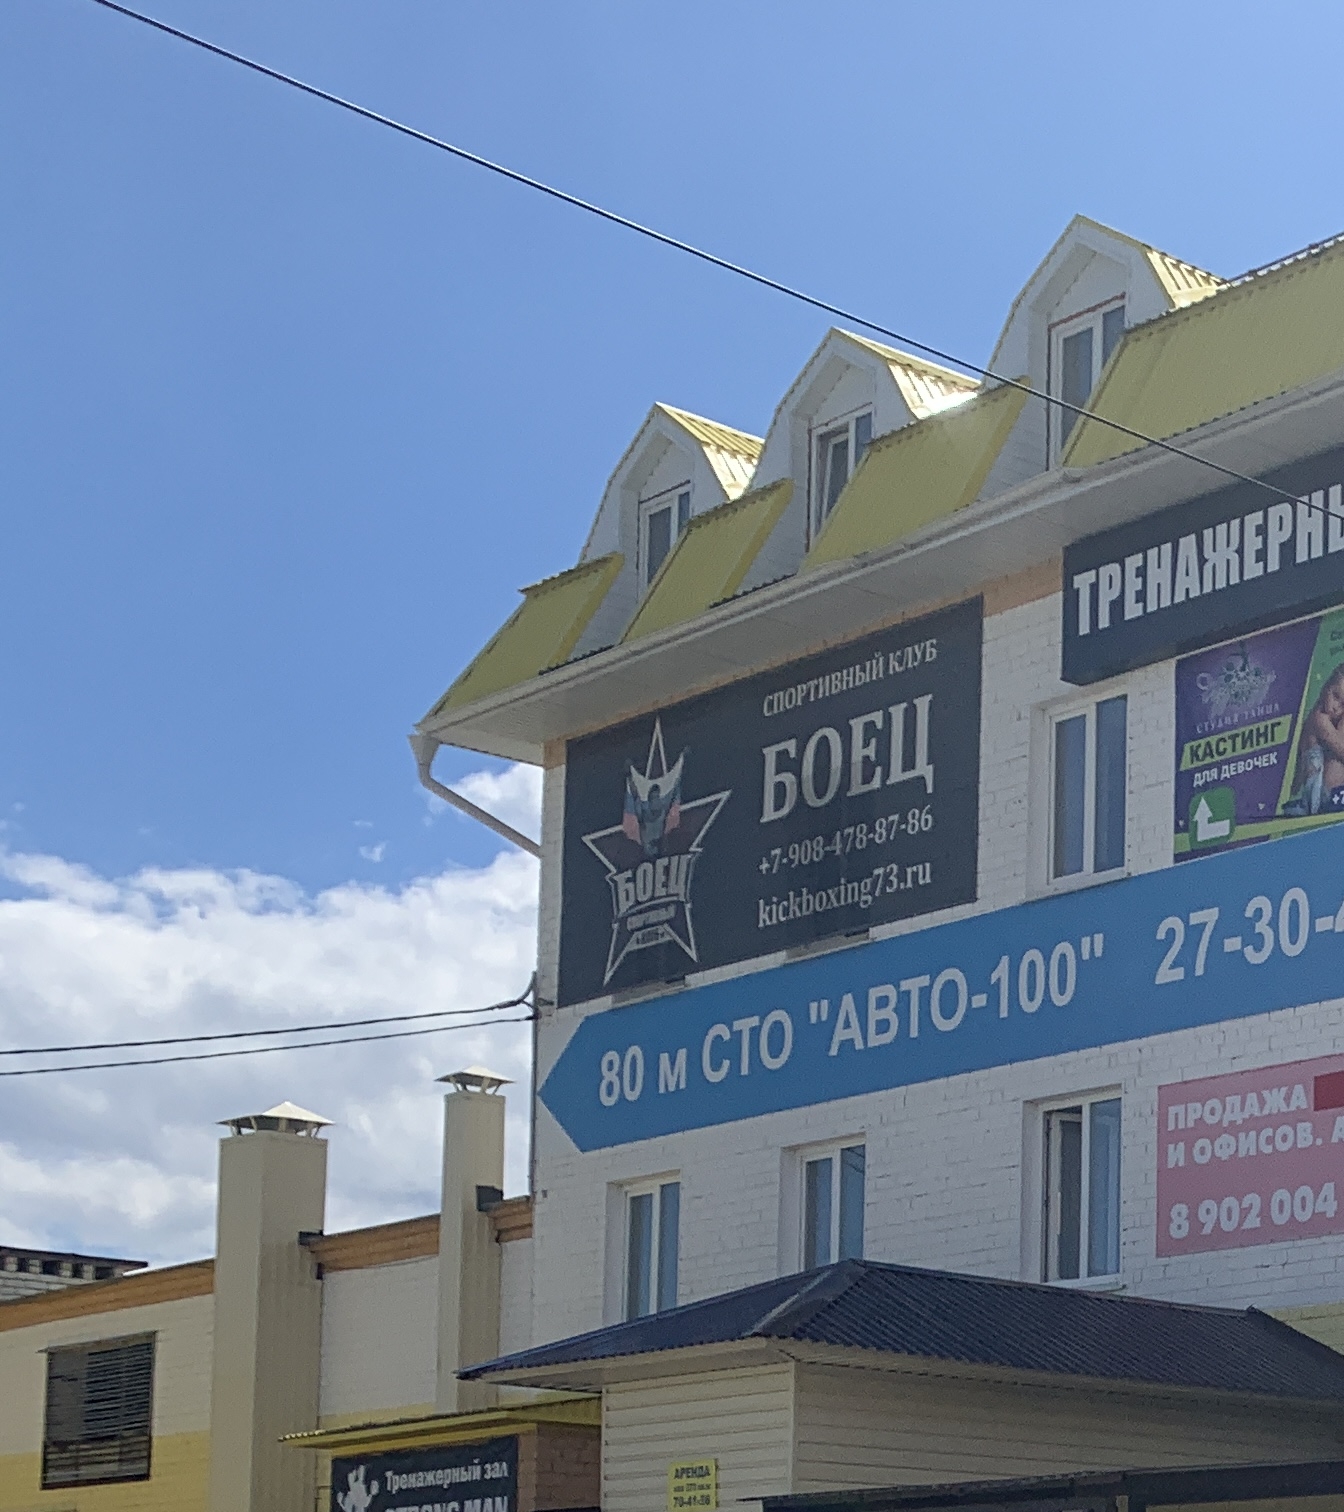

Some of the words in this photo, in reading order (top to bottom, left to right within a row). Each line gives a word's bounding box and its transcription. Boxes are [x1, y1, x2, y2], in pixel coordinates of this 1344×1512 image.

[763, 651, 885, 717] СПОРТИВНЫЙ
[888, 639, 937, 675] КЛУБ
[759, 694, 935, 823] БОЕЦ
[1189, 721, 1281, 764] КАСТИНГ
[1193, 767, 1218, 787] ДЛЯ
[1221, 751, 1278, 780] ДЕВОЧЕК
[758, 805, 933, 874] +7-908-478-87-86
[612, 853, 694, 918] БОЕЦ
[757, 862, 932, 928] kickboxing73.ru
[600, 1045, 644, 1107] 80
[702, 1009, 794, 1084] СТО
[810, 934, 1105, 1057] "АВТО-100"
[1167, 1083, 1309, 1131] ПРОДАЖА
[1167, 1142, 1185, 1168] И
[1192, 1121, 1322, 1165] ОФИСОВ.
[1168, 1203, 1189, 1239] 8
[1198, 1193, 1262, 1235] 902
[1270, 1182, 1338, 1225] 004
[384, 1458, 481, 1494] Тренажерный
[484, 1461, 509, 1479] зал
